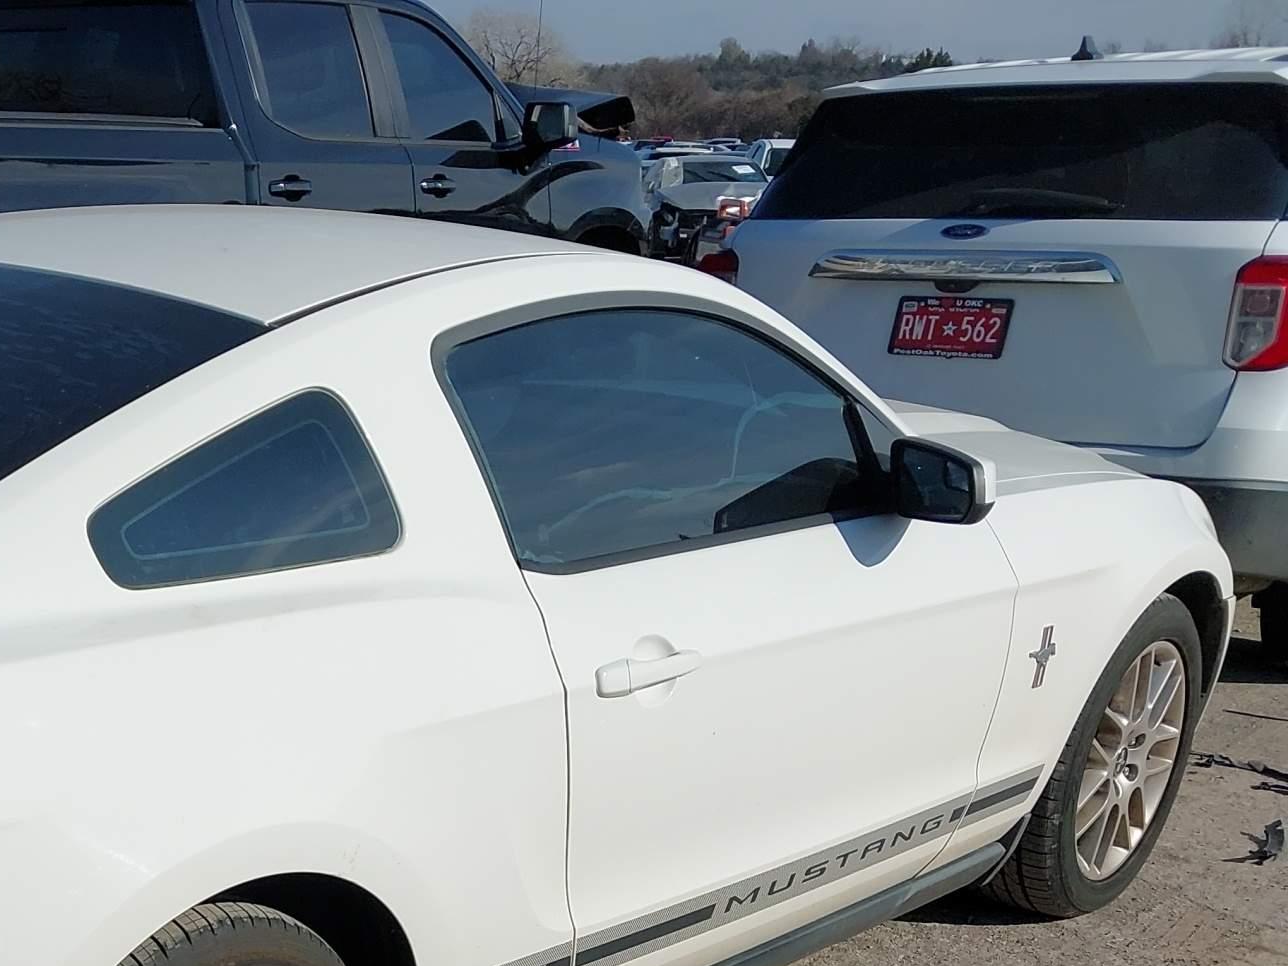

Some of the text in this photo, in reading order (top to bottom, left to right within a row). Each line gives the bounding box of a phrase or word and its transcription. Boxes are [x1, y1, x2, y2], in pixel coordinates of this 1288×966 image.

[898, 314, 1001, 343] RWT 562
[893, 348, 993, 358] PostOakToyota.com
[723, 814, 945, 914] MUSTANG
